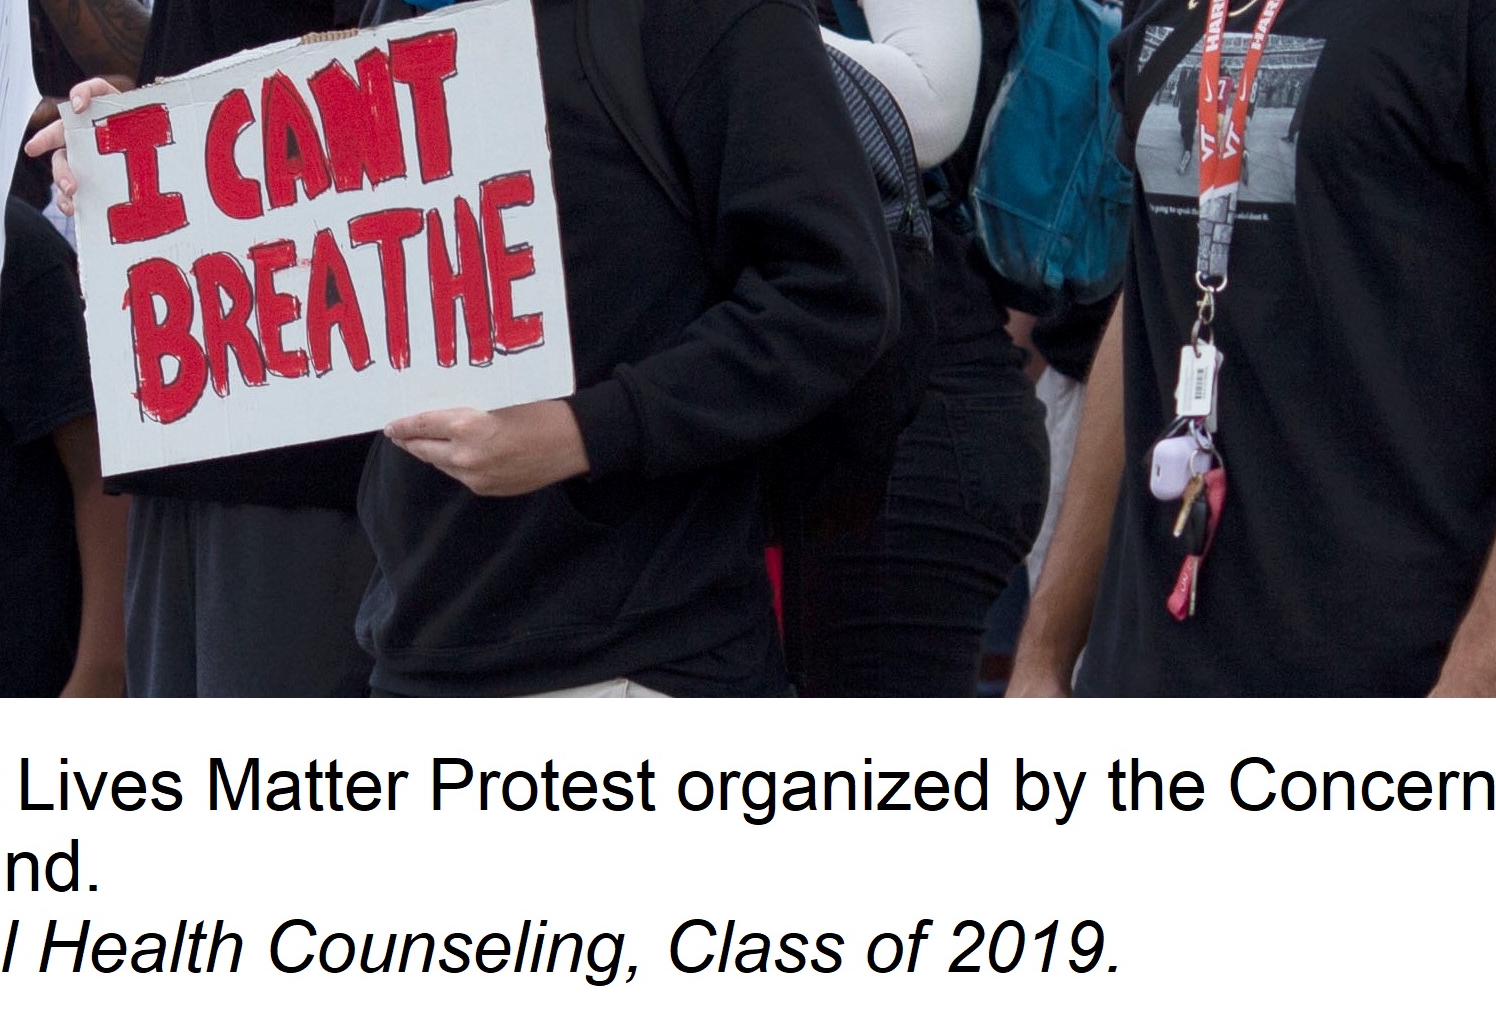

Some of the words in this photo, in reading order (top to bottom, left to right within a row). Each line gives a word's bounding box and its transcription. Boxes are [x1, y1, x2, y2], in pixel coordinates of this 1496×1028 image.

[92, 102, 190, 245] I
[205, 28, 458, 220] CANT
[122, 170, 545, 425] BREATHE
